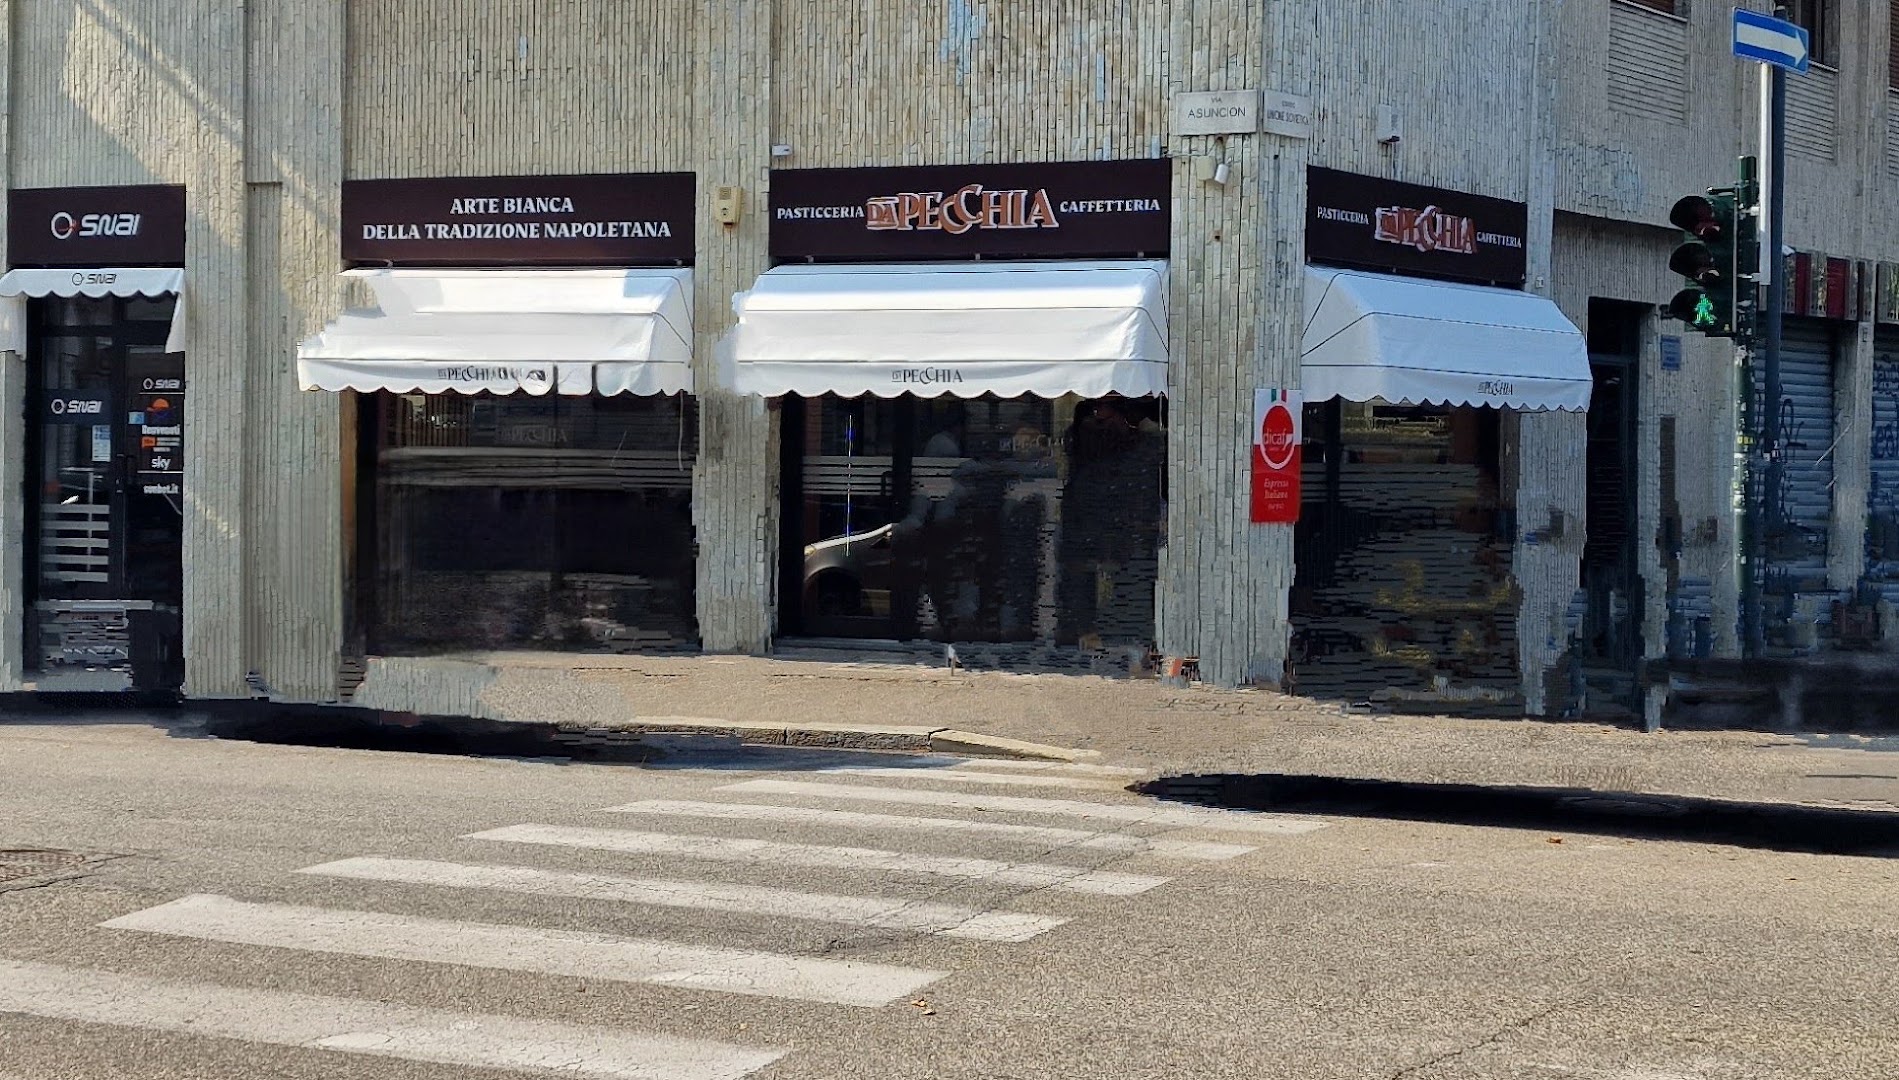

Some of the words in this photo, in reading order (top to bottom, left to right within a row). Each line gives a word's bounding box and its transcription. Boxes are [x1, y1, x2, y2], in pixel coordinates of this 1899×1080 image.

[1188, 106, 1246, 119] ASUNCION
[450, 197, 499, 215] ARTE
[503, 196, 574, 214] BIANCA
[776, 204, 865, 220] PASTICCERIA
[898, 184, 1060, 234] PECCHIA
[1060, 198, 1160, 214] CAFFETTERIA
[362, 223, 421, 240] DELLA
[425, 222, 540, 240] TRADIZIONE
[544, 221, 672, 239] NAPOLETANA
[1317, 205, 1370, 226] PASTICCERIA
[1477, 231, 1522, 249] CAFFETTERIA
[903, 366, 963, 385] PECCHIA
[151, 455, 171, 471] sky
